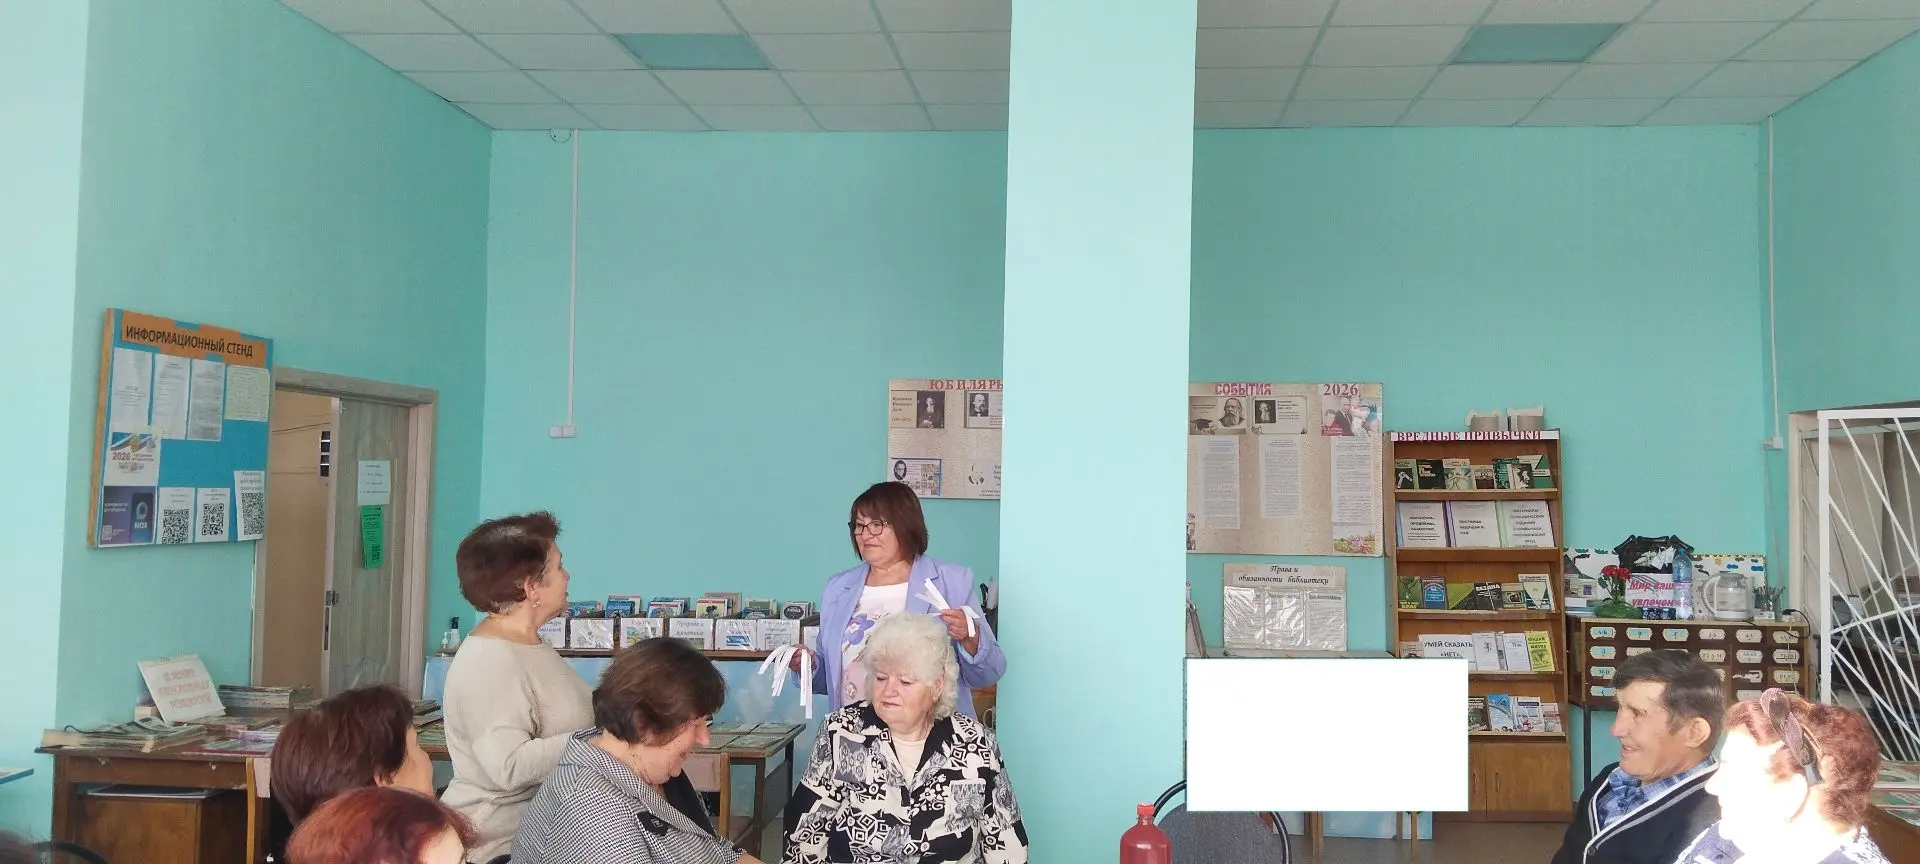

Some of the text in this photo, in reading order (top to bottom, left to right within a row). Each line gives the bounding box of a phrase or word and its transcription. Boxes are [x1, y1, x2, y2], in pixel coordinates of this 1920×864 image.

[126, 325, 253, 357] ИНФОРМАЦИОННЫЙ СТЕНД
[1215, 383, 1272, 396] СОБЫТИЯ
[1323, 383, 1359, 396] 2026
[1397, 430, 1541, 441] ВРЕДНЫЕ ПРИВЫЧКИ
[112, 452, 131, 461] 2026
[1270, 565, 1292, 574] Права
[1238, 573, 1283, 583] обязанности
[1630, 580, 1651, 591] Мир
[1423, 640, 1443, 648] УМЕЙ
